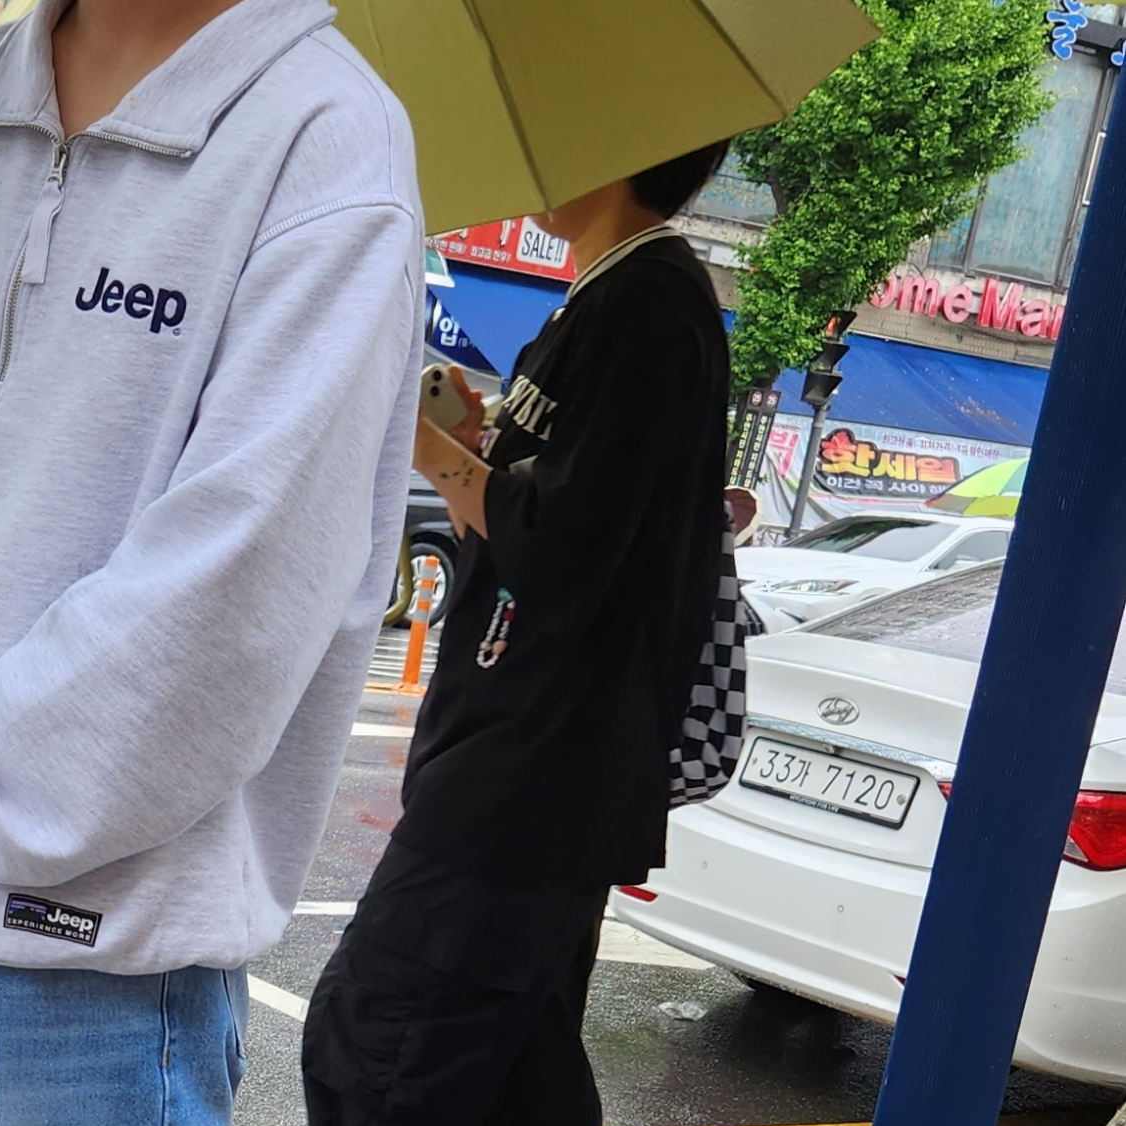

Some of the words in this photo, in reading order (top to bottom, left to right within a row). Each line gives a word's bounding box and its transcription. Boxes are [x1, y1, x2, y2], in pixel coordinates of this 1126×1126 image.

[75, 266, 187, 334] Jeep
[759, 750, 812, 788] 33가
[821, 764, 895, 811] 7120
[7, 917, 63, 935] EXPERIENCE
[65, 929, 92, 942] MORE
[46, 907, 94, 932] Jeep
